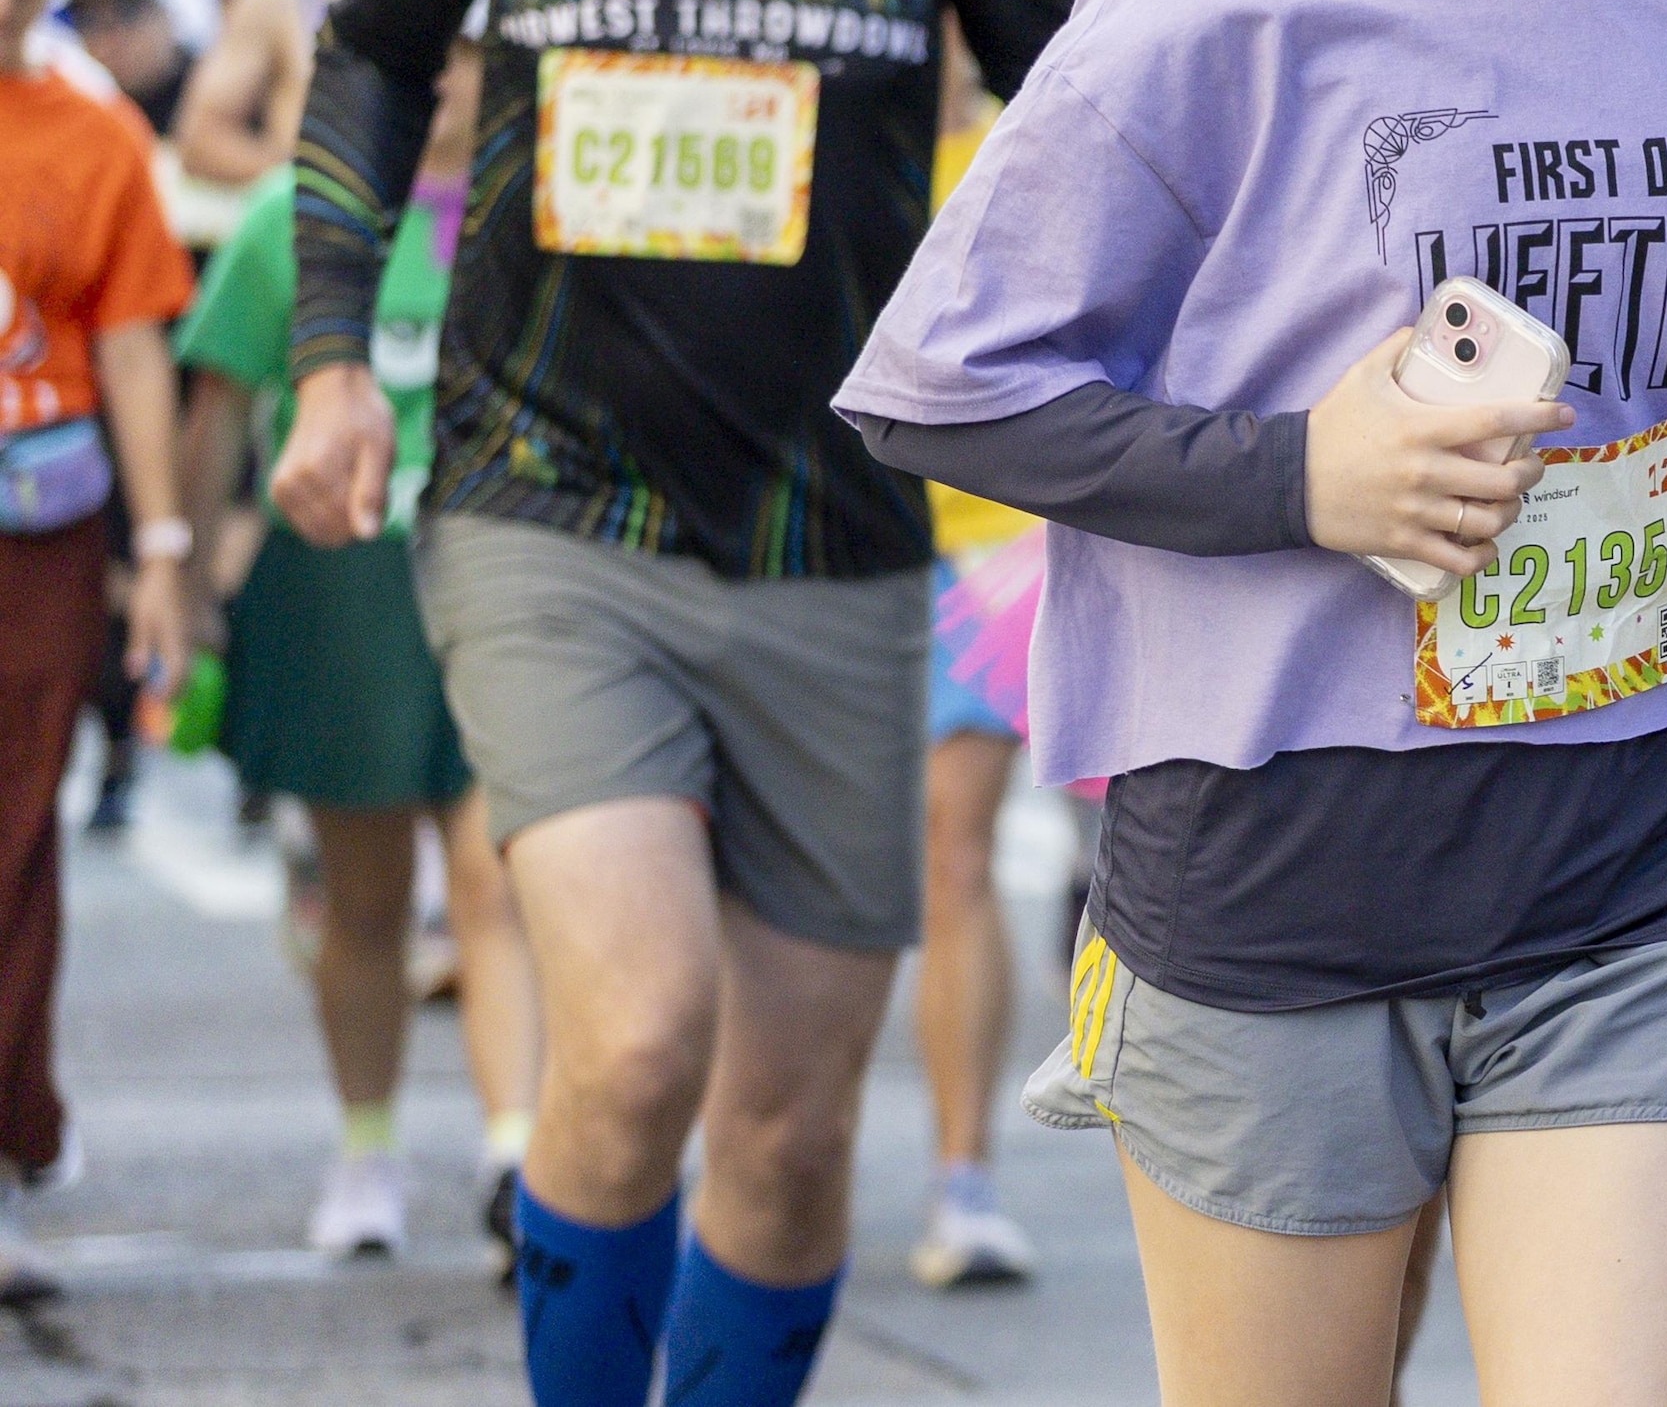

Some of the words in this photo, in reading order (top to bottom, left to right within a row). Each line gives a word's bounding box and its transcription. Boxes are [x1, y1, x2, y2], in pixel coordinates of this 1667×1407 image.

[1493, 138, 1621, 203] FIRST
[1534, 485, 1580, 503] windsurf
[1526, 513, 1548, 523] 2025
[1497, 671, 1522, 680] ULTRA
